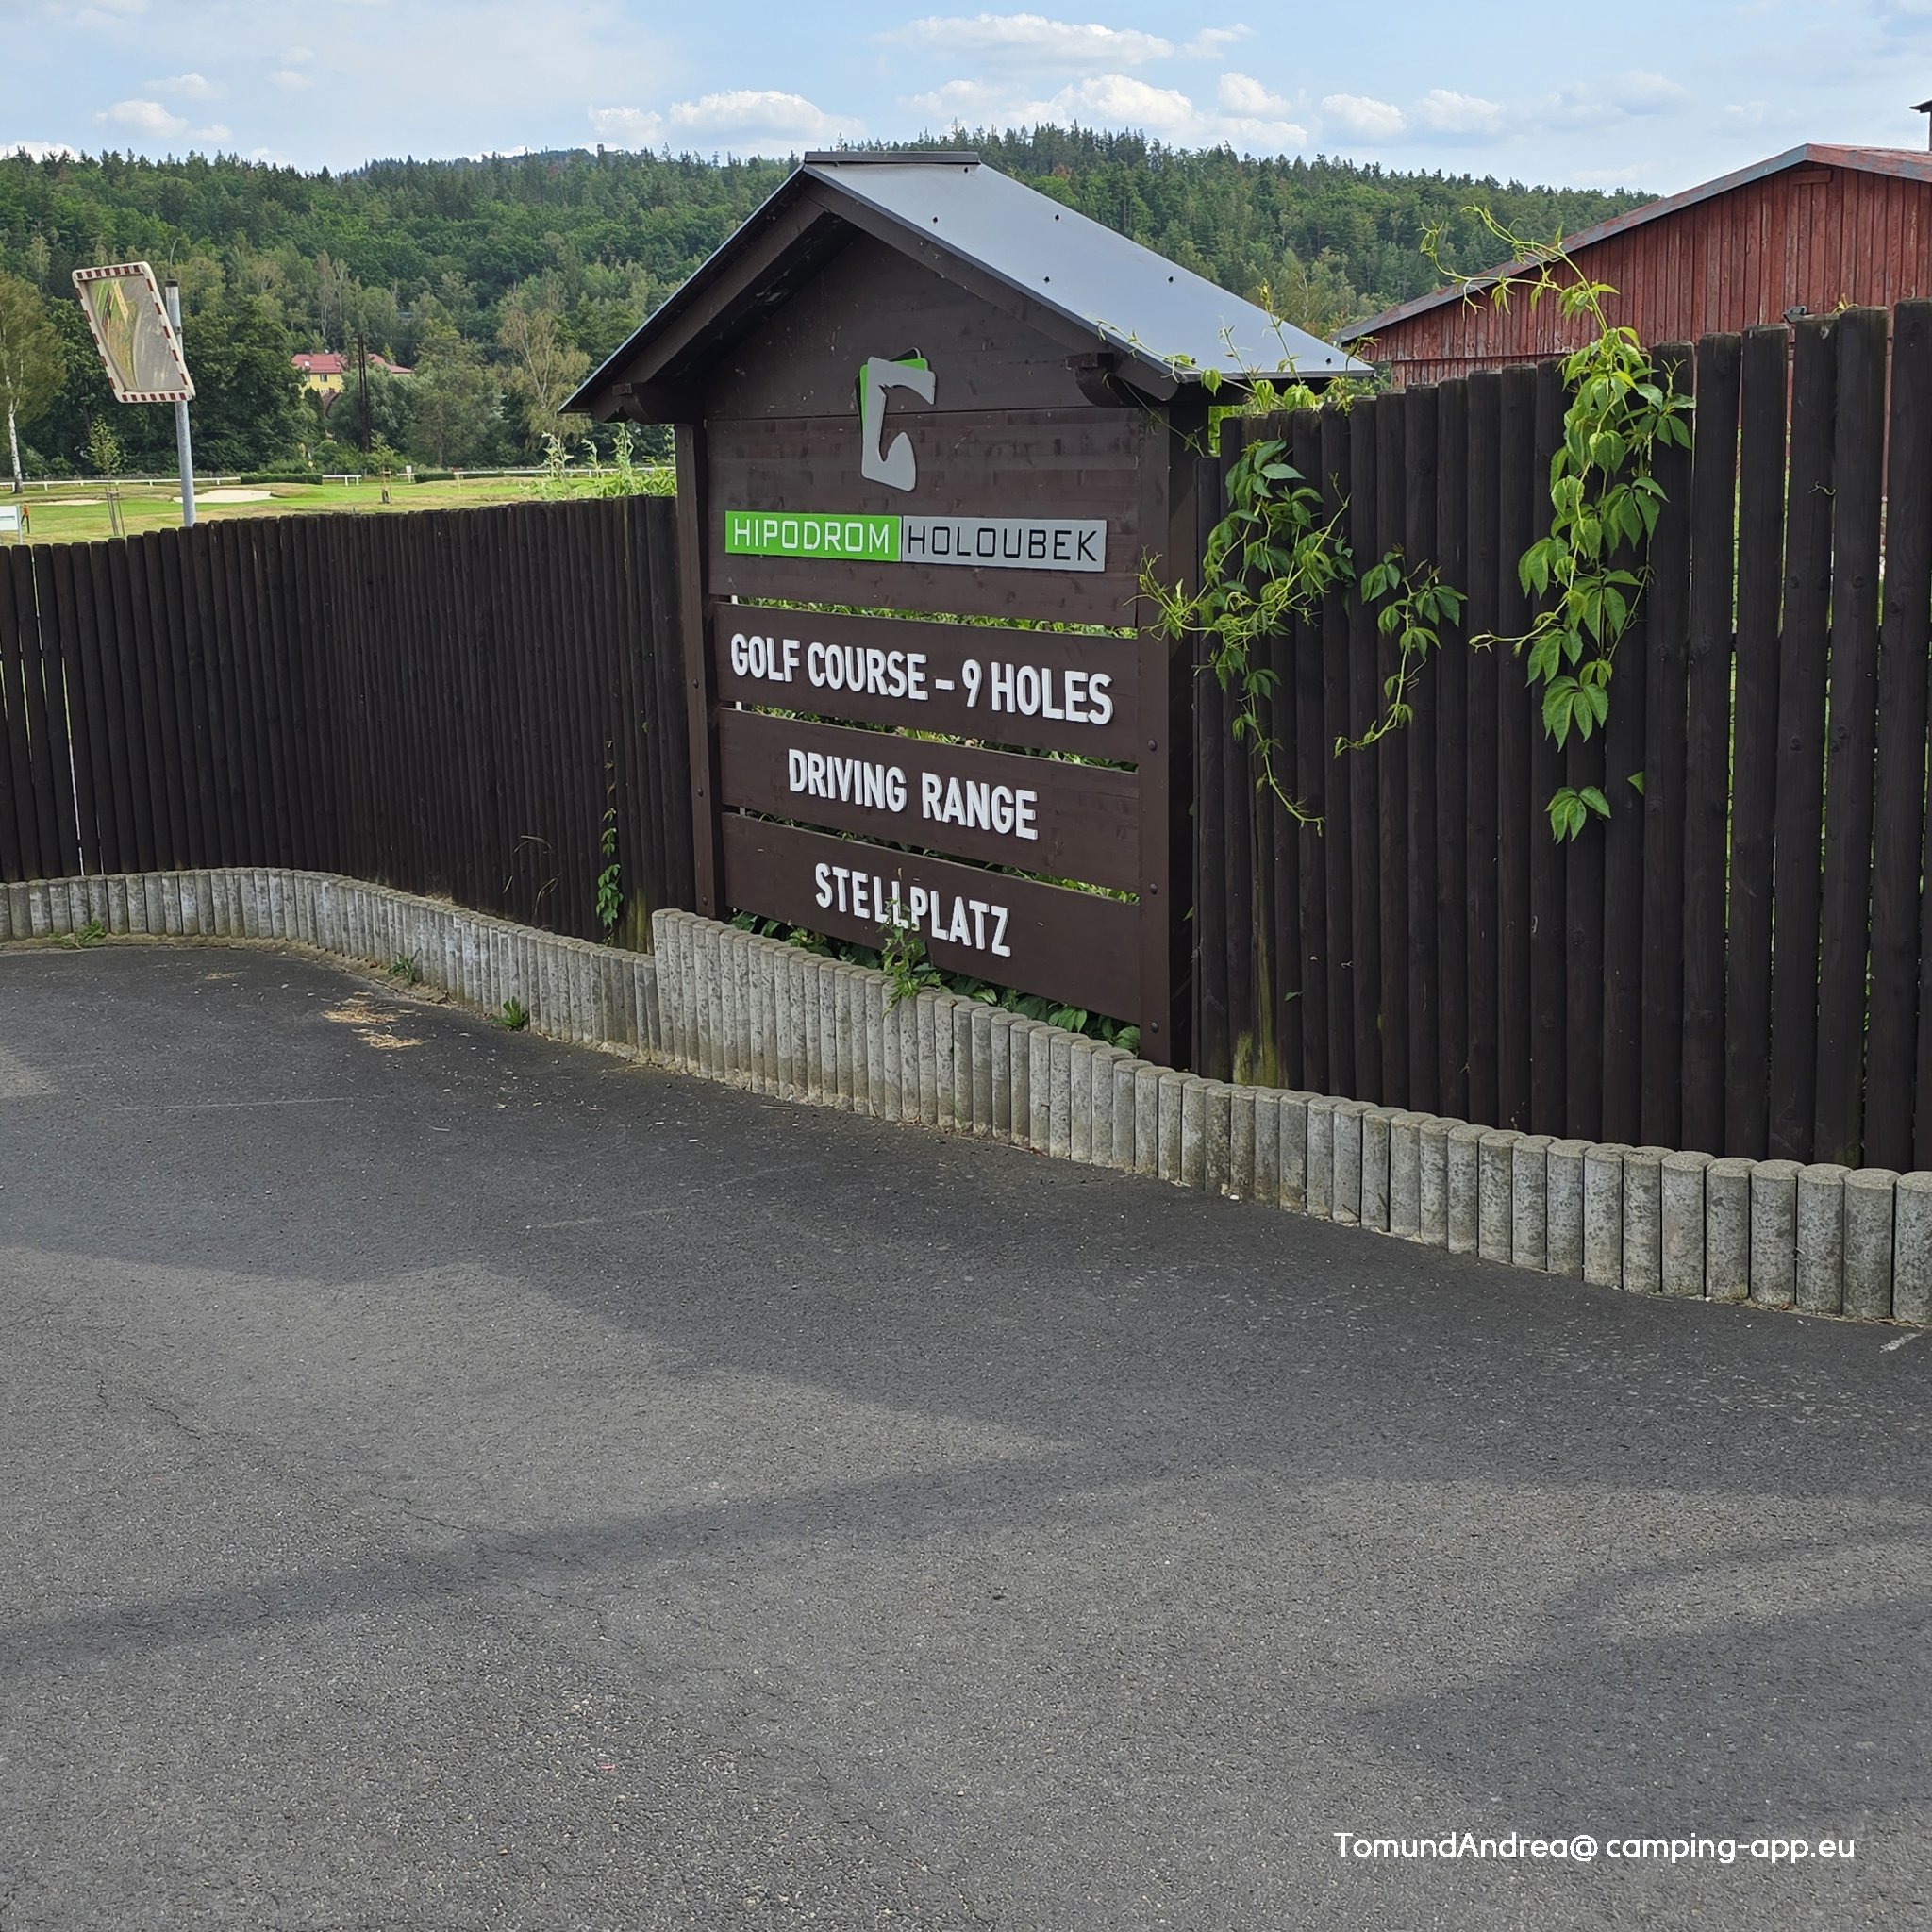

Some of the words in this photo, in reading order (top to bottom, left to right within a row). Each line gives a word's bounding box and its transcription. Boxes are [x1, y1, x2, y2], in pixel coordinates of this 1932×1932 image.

[733, 518, 890, 554] HIPODROM
[908, 525, 1098, 562] HOLOUBEK
[731, 633, 800, 682] GOLF
[808, 642, 929, 701] COURSE
[962, 659, 983, 708] 9
[991, 661, 1113, 724] HOLES
[788, 749, 907, 812] DRIVING
[922, 772, 1038, 841] RANGE
[815, 863, 1010, 957] STELLPLATZ
